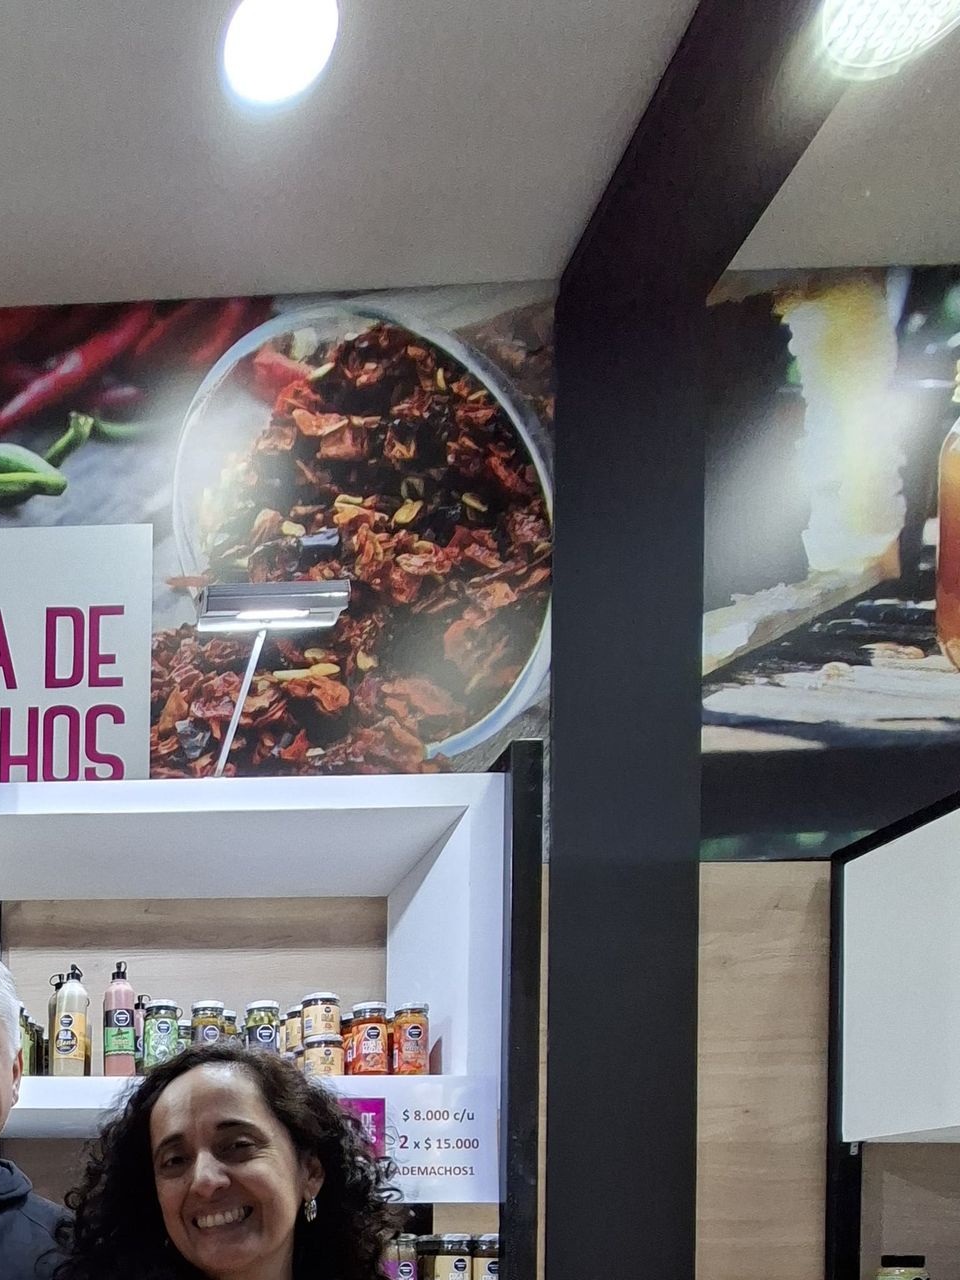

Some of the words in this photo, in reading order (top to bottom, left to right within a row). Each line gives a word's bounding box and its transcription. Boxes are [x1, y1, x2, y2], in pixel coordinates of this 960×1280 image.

[45, 605, 125, 689] DE
[403, 1109, 410, 1122] $
[413, 1110, 449, 1121] 8.000
[453, 1108, 475, 1122] c/u
[399, 1135, 409, 1149] 2
[413, 1141, 420, 1149] x
[424, 1137, 432, 1150] $
[436, 1138, 479, 1149] 15.000
[393, 1165, 475, 1176] ADEMACHOS1
